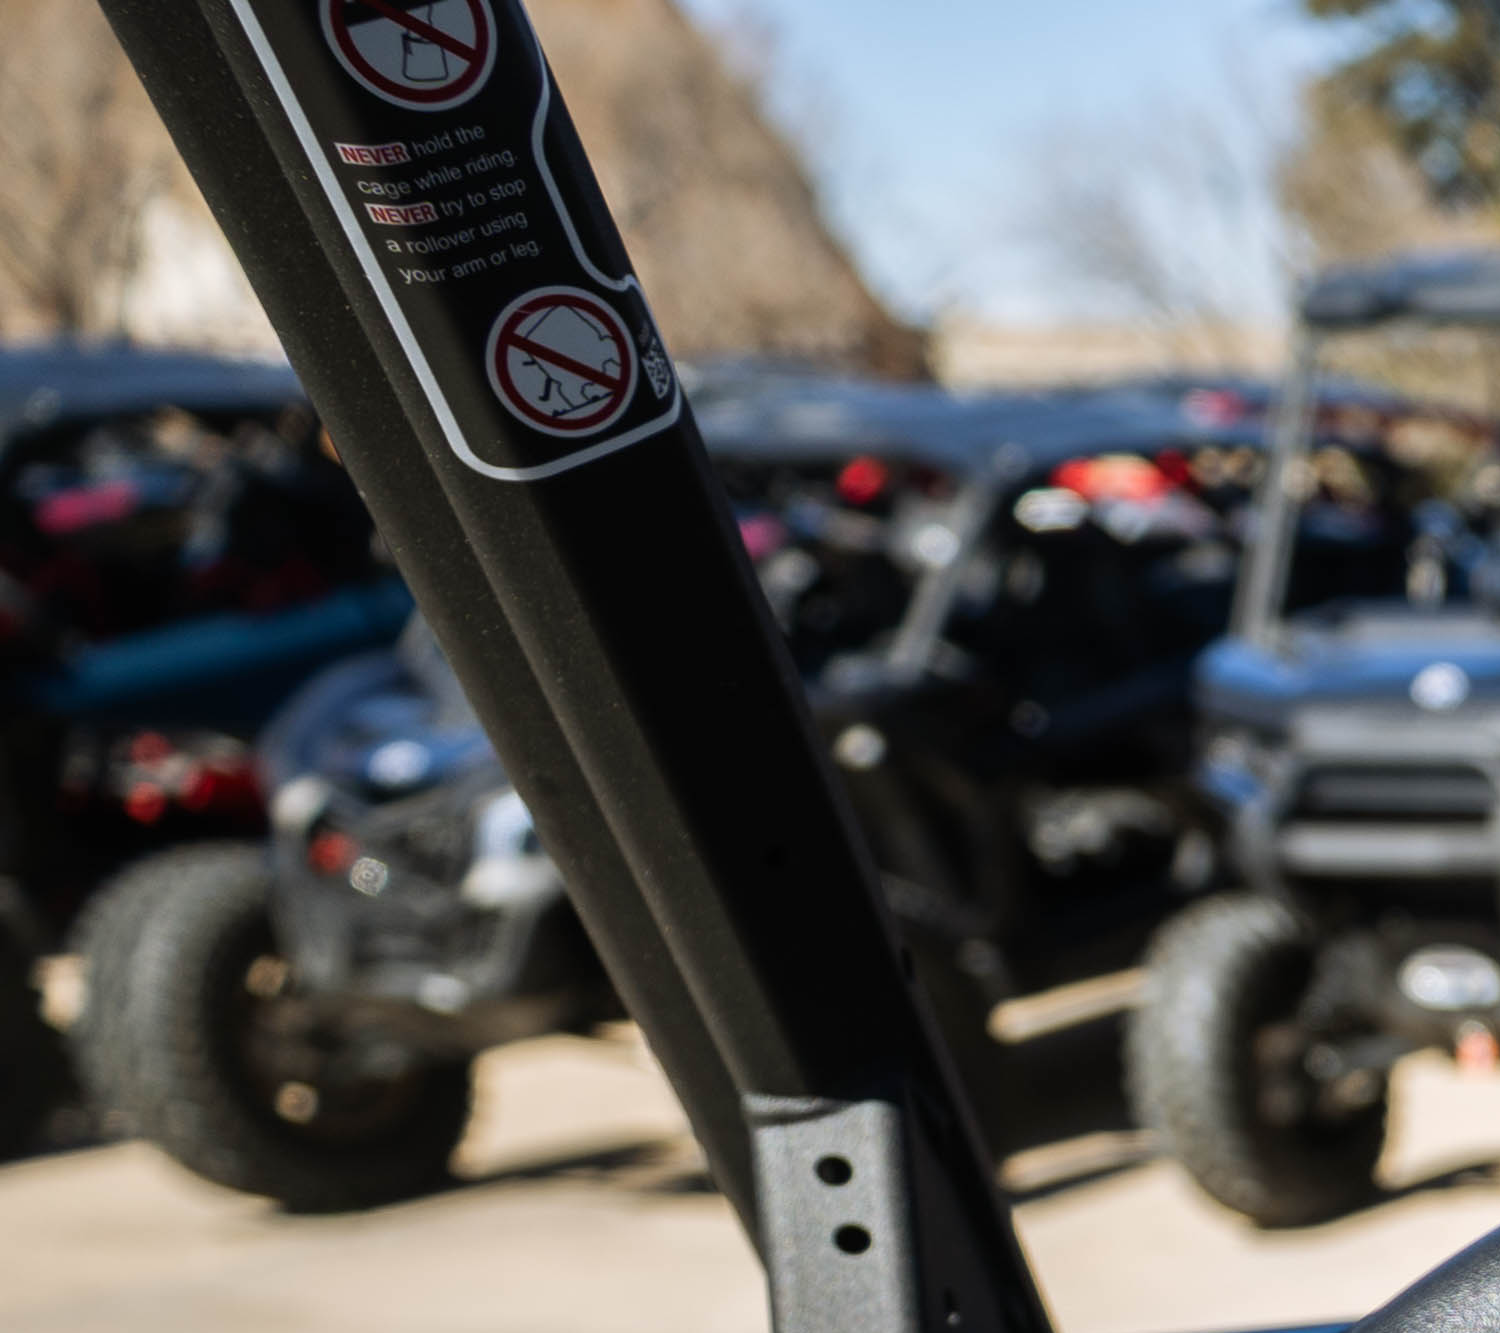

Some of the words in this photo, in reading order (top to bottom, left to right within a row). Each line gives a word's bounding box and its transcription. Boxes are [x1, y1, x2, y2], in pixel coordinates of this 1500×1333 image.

[340, 145, 410, 164] NEVER
[412, 136, 453, 157] hold
[456, 125, 485, 143] the
[358, 181, 411, 199] cage
[414, 165, 462, 191] while
[466, 150, 517, 174] riding.
[370, 204, 437, 223] NEVER
[440, 201, 464, 216] try
[467, 191, 486, 208] to
[489, 179, 526, 199] stop
[387, 239, 401, 252] a
[408, 227, 476, 254] rollover
[481, 212, 528, 236] using
[400, 268, 446, 284] your
[452, 258, 487, 278] arm
[490, 249, 508, 265] or
